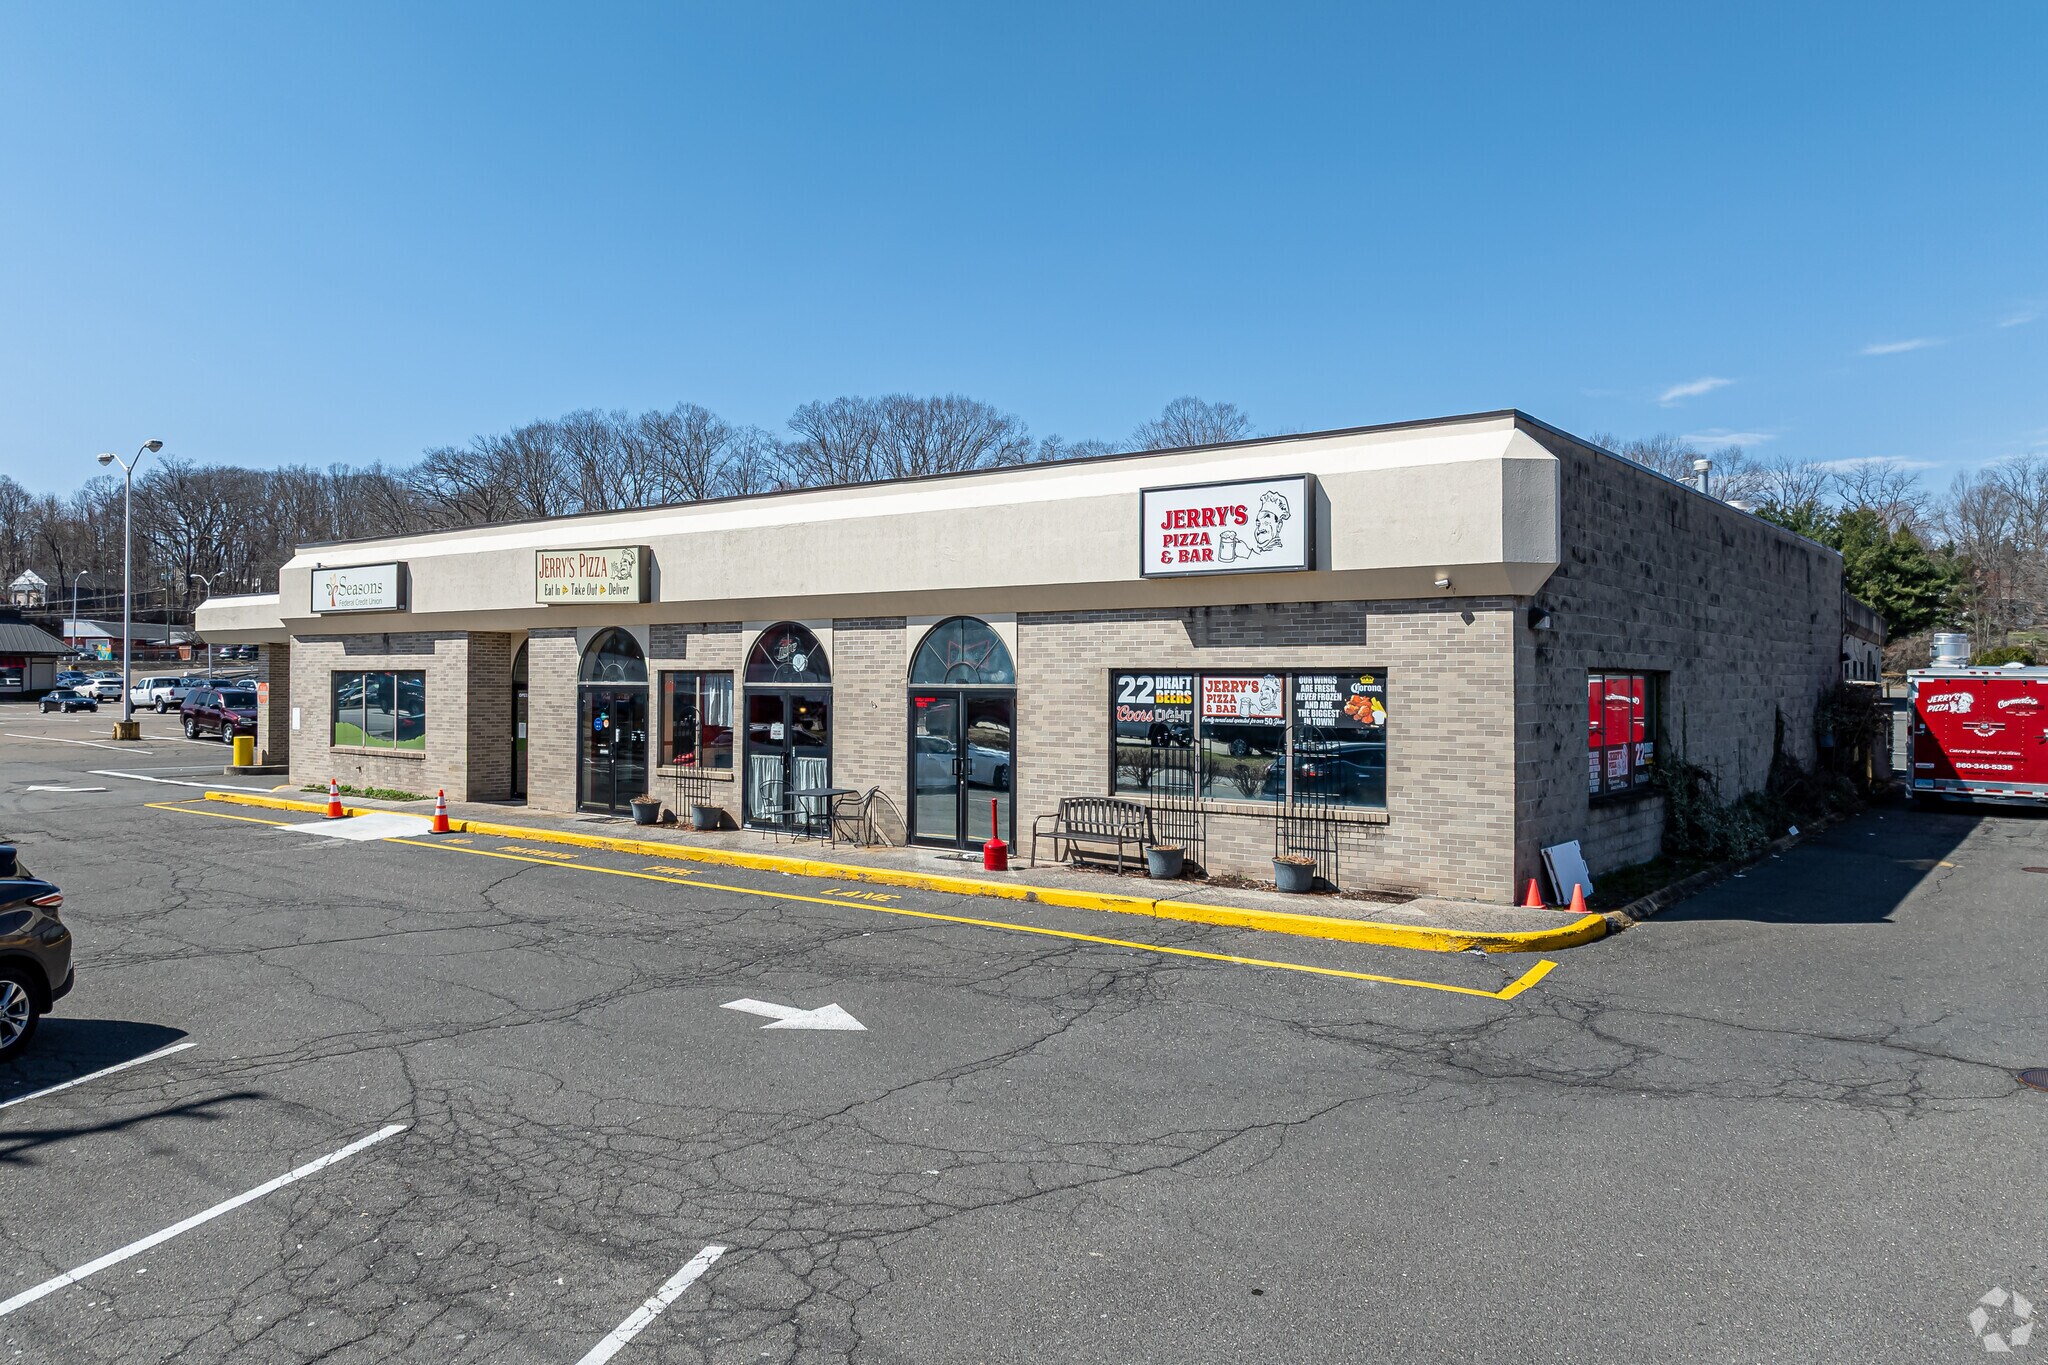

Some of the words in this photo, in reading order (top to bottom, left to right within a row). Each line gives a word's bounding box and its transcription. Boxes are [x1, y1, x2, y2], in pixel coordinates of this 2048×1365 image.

[1161, 505, 1248, 530] JERRY'S
[1163, 532, 1212, 548] PIZZA
[1161, 550, 1173, 564] &
[1178, 548, 1214, 563] BAR
[539, 554, 575, 579] JERRY'S
[579, 553, 608, 578] PIZZA
[338, 575, 383, 597] Seasons
[544, 584, 554, 596] Eat
[555, 584, 561, 596] In
[571, 583, 586, 596] Take
[587, 583, 598, 596] Out
[608, 582, 630, 596] Deliver
[339, 599, 354, 607] Federal
[355, 598, 368, 606] Credit
[369, 597, 383, 605] Union
[1298, 676, 1313, 684] OUR
[1313, 676, 1338, 684] WINGS
[1117, 675, 1155, 704] 22
[1155, 675, 1192, 690] DRAFT
[1205, 680, 1259, 693] JERRY'S
[1300, 684, 1313, 692] ARE
[1350, 682, 1383, 694] Corona
[1155, 690, 1192, 704] BEERS
[1206, 694, 1237, 704] PIZZA
[1296, 693, 1317, 701] NEVER
[1317, 693, 1342, 701] FROZEN
[1926, 692, 1961, 704] JERRY'S
[1206, 705, 1213, 713] &
[1215, 705, 1237, 713] BAR
[1304, 701, 1319, 709] AND
[1319, 701, 1333, 709] ARE
[1926, 704, 1949, 713] PIZZA
[1116, 704, 1154, 722] Coors
[1297, 709, 1310, 717] THE
[1310, 709, 1340, 718] BIGGEST
[1264, 717, 1273, 726] 50
[1303, 717, 1311, 725] IN
[1312, 717, 1335, 726] TOWN!
[1635, 743, 1645, 766] 22
[641, 865, 703, 876] FIRE
[820, 887, 902, 902] LANE
